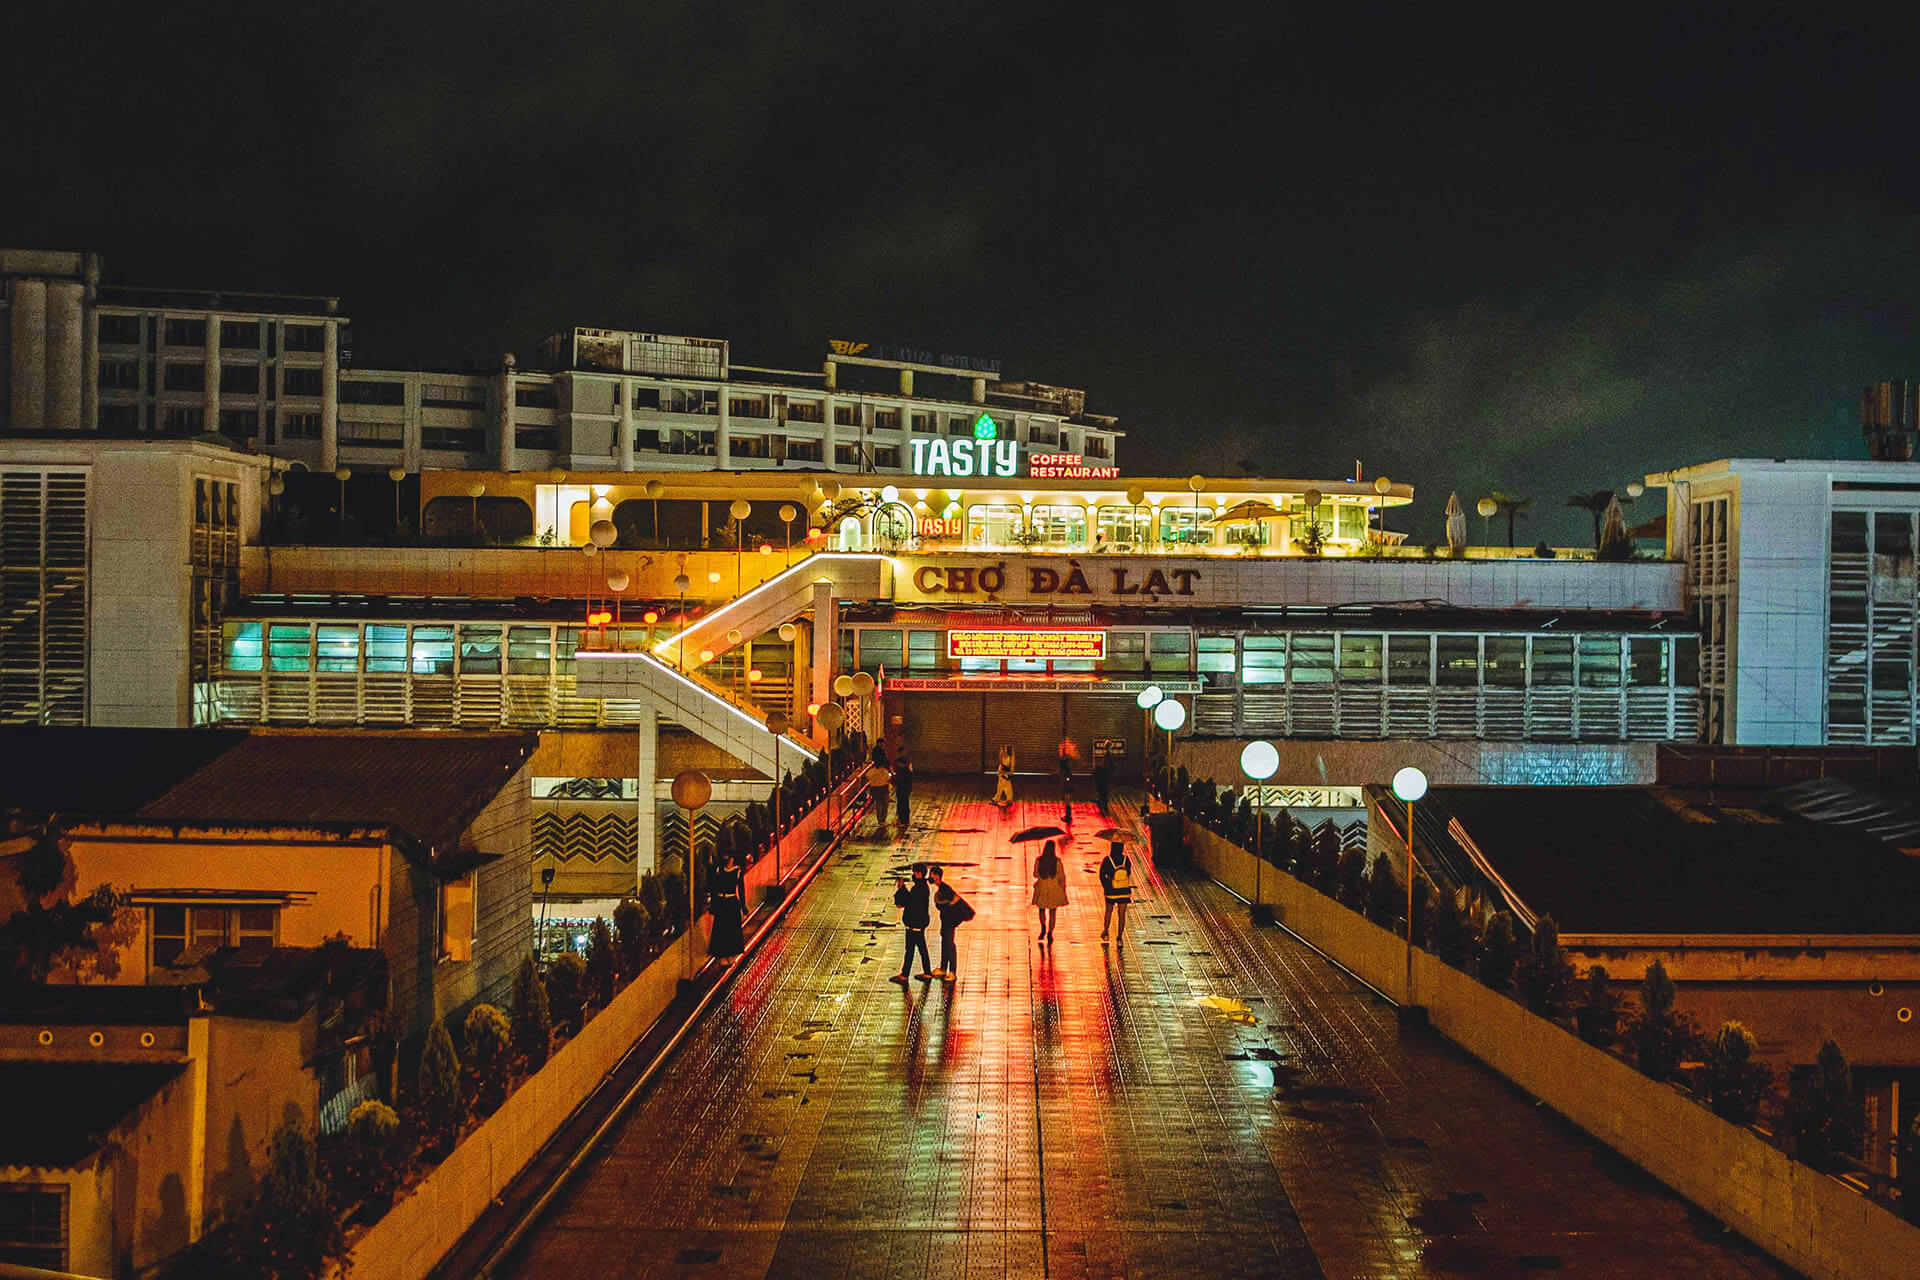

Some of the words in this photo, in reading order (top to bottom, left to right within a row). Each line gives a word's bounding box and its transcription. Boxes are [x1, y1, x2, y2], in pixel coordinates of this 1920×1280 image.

[909, 438, 1018, 477] TASTY
[1030, 454, 1082, 466] COFFEE
[1030, 466, 1120, 478] RESTAURANT
[917, 517, 962, 535] TASTY
[913, 561, 1005, 600] CHỢ
[1029, 559, 1093, 594] ĐÀ
[1112, 567, 1201, 602] LẠT
